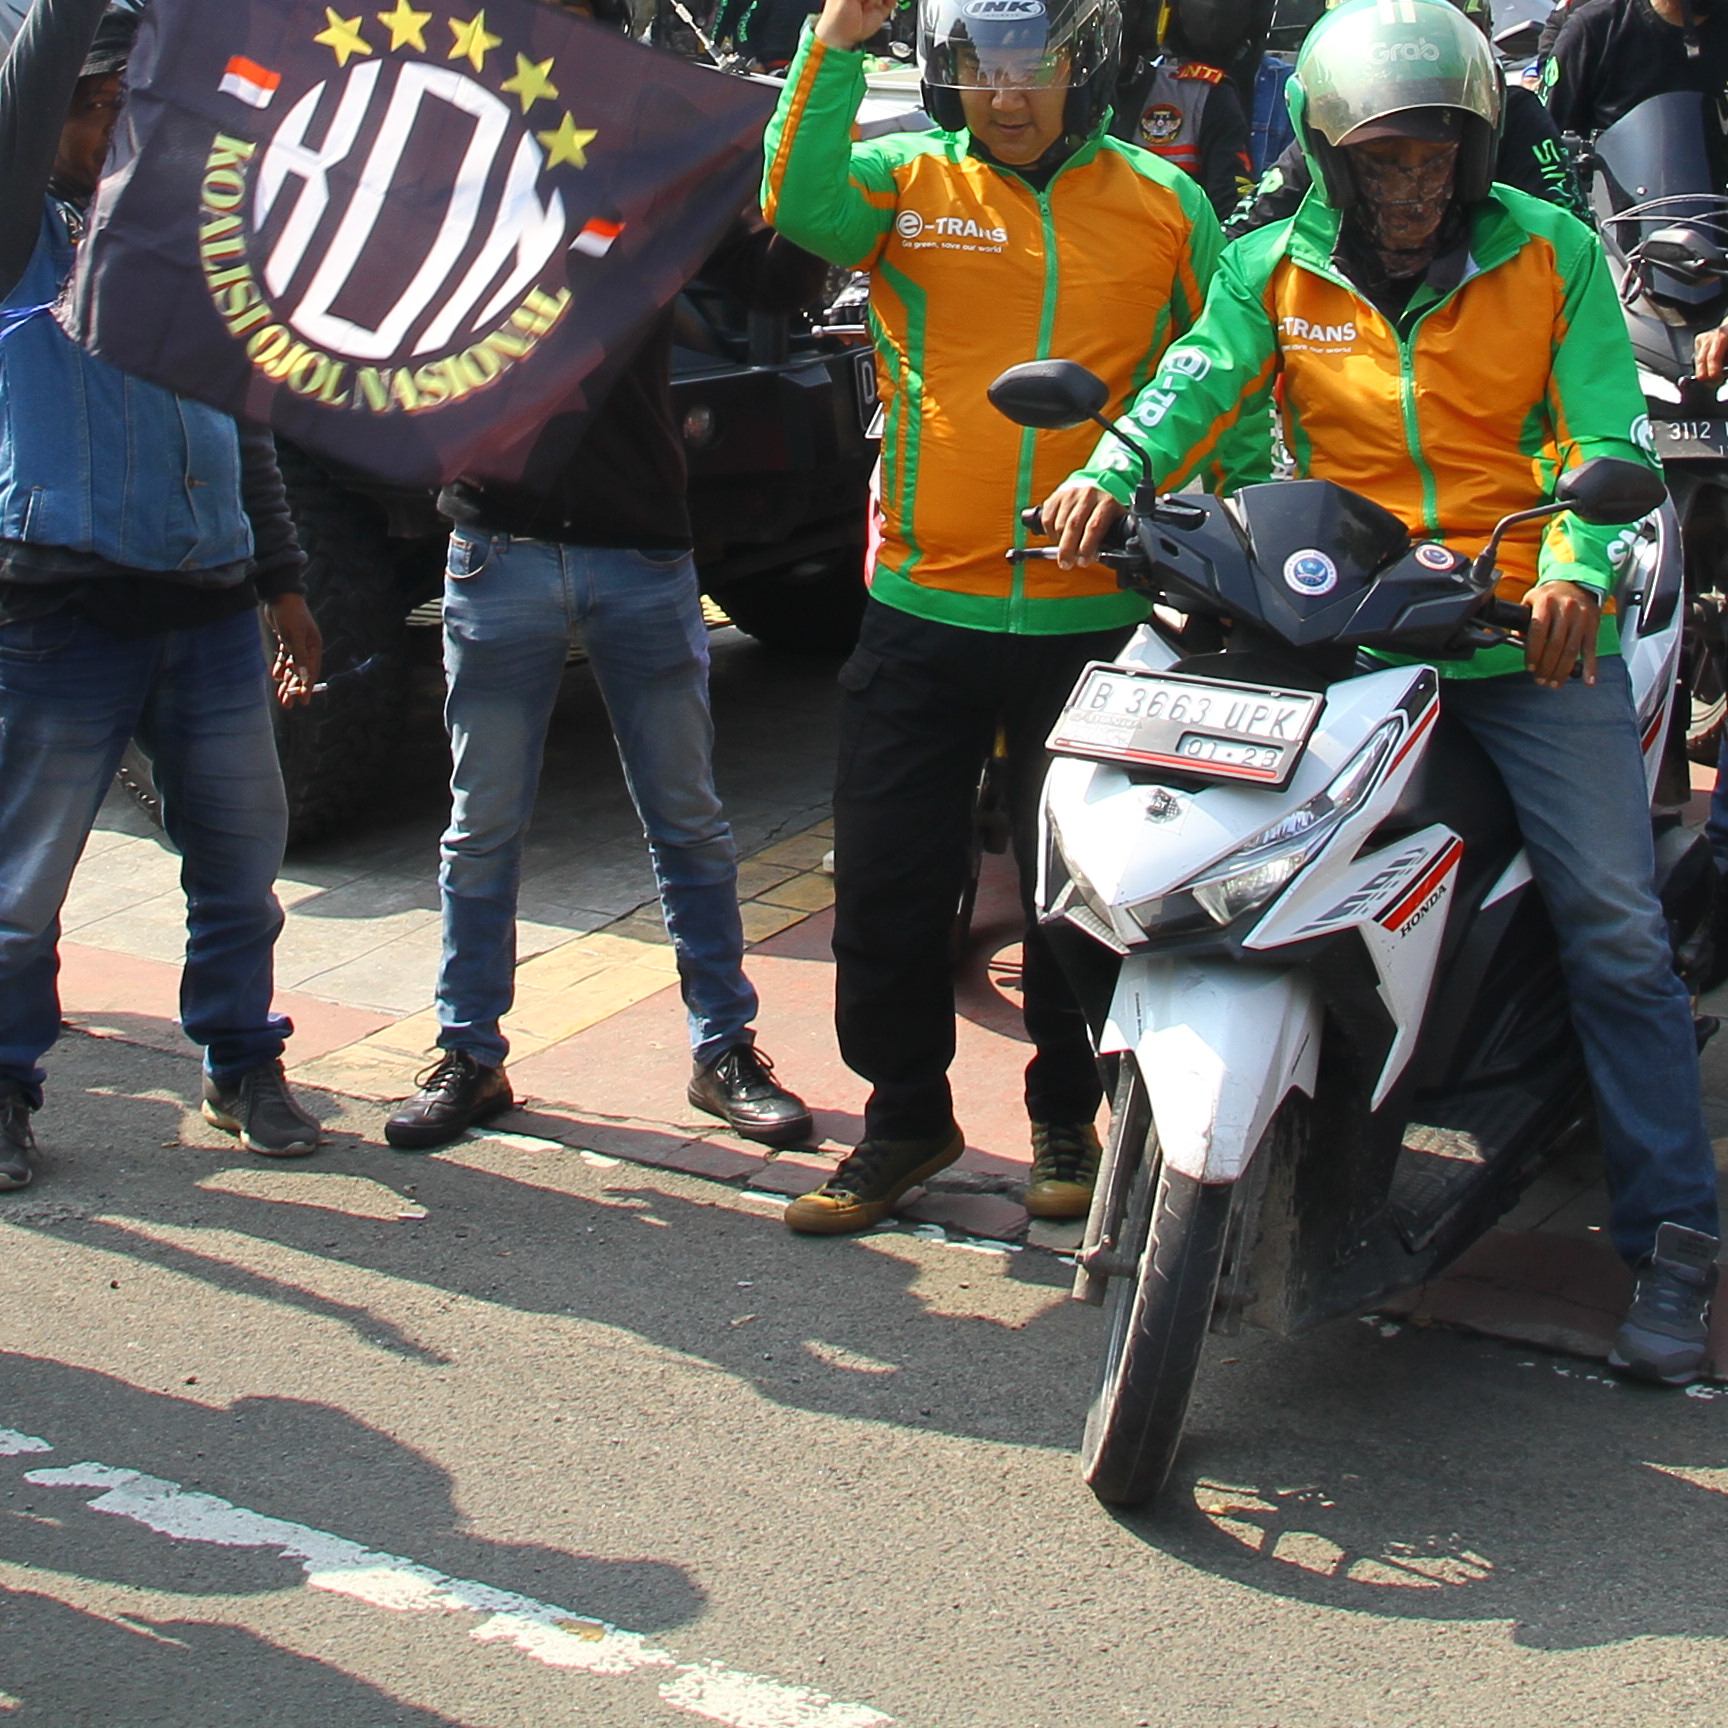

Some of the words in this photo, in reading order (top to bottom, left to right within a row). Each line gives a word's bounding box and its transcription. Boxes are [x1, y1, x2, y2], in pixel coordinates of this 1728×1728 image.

[972, 1, 1035, 13] INK
[1372, 37, 1440, 63] Grab
[896, 210, 1008, 243] e-TRANS
[914, 240, 939, 249] green,
[941, 242, 961, 250] save
[978, 245, 1002, 254] world
[199, 131, 272, 338] KOALISI
[246, 324, 352, 407] OJOL
[352, 284, 572, 413] NASIONAL
[1278, 317, 1357, 342] -TRANS
[1668, 421, 1711, 441] 3112
[1090, 682, 1114, 710] B
[1125, 688, 1211, 724] 3663
[1224, 701, 1296, 739] UPK
[1400, 883, 1448, 939] HONDA
